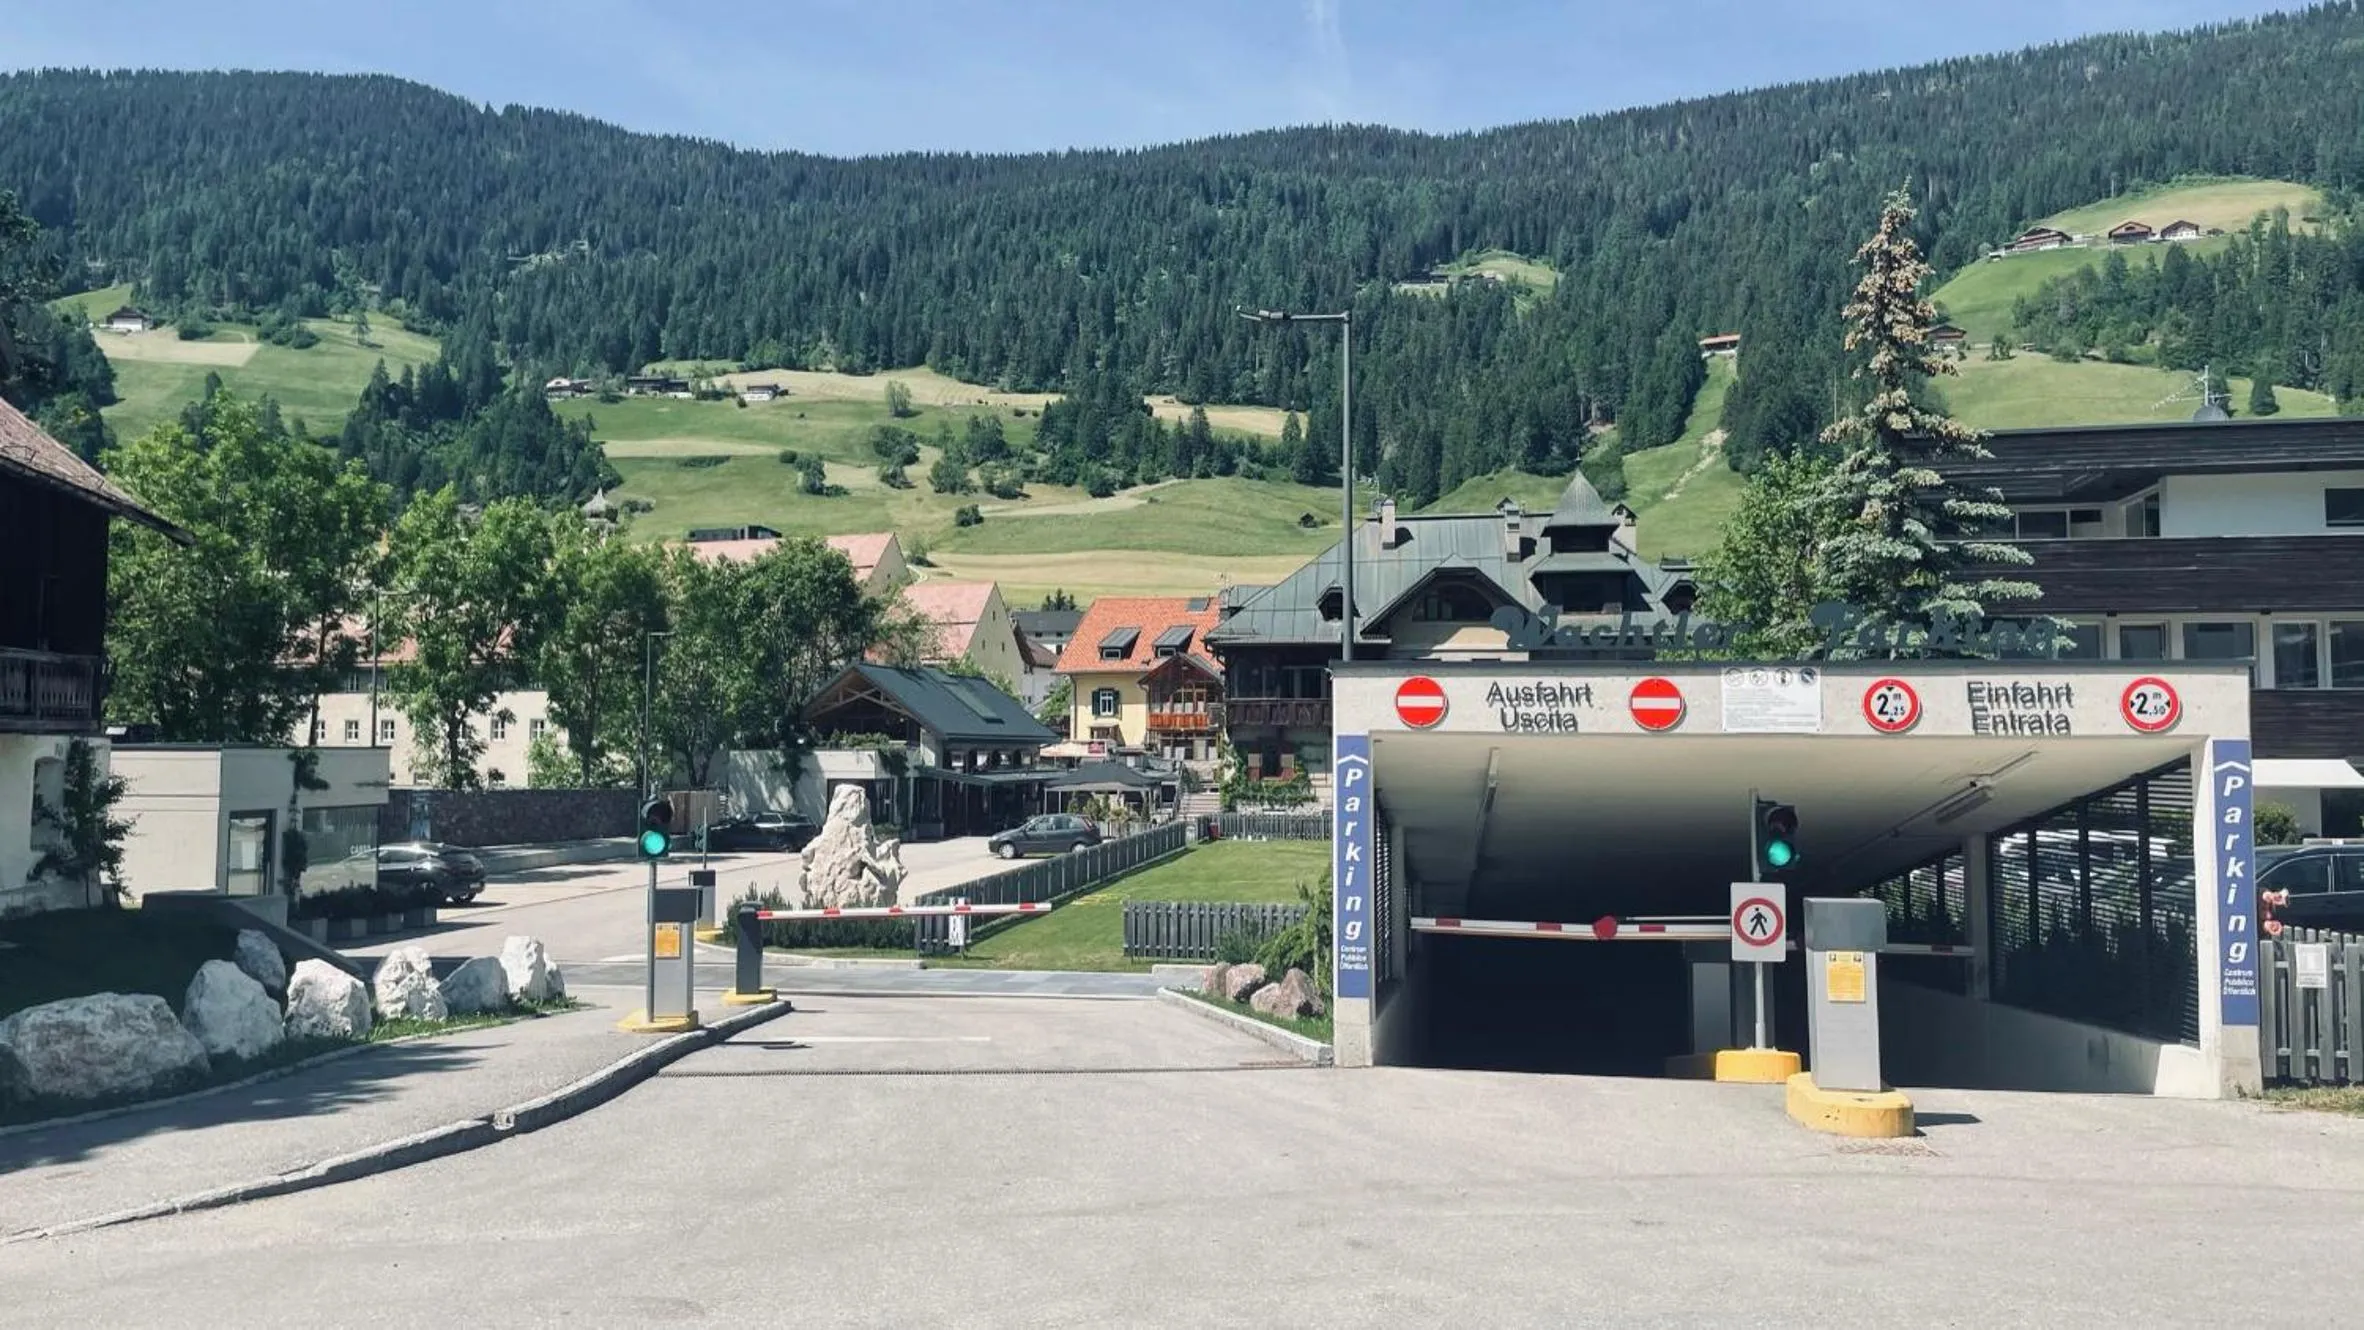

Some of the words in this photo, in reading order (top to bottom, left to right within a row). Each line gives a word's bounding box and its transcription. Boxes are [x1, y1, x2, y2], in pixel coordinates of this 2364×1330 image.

[1486, 680, 1593, 704] Ausfahrt
[1967, 680, 2073, 704] Einfahrt
[1500, 707, 1578, 731] Uscita
[1972, 707, 2070, 732] Entrata
[1344, 767, 1364, 941] Parking
[2223, 775, 2248, 964] Parking
